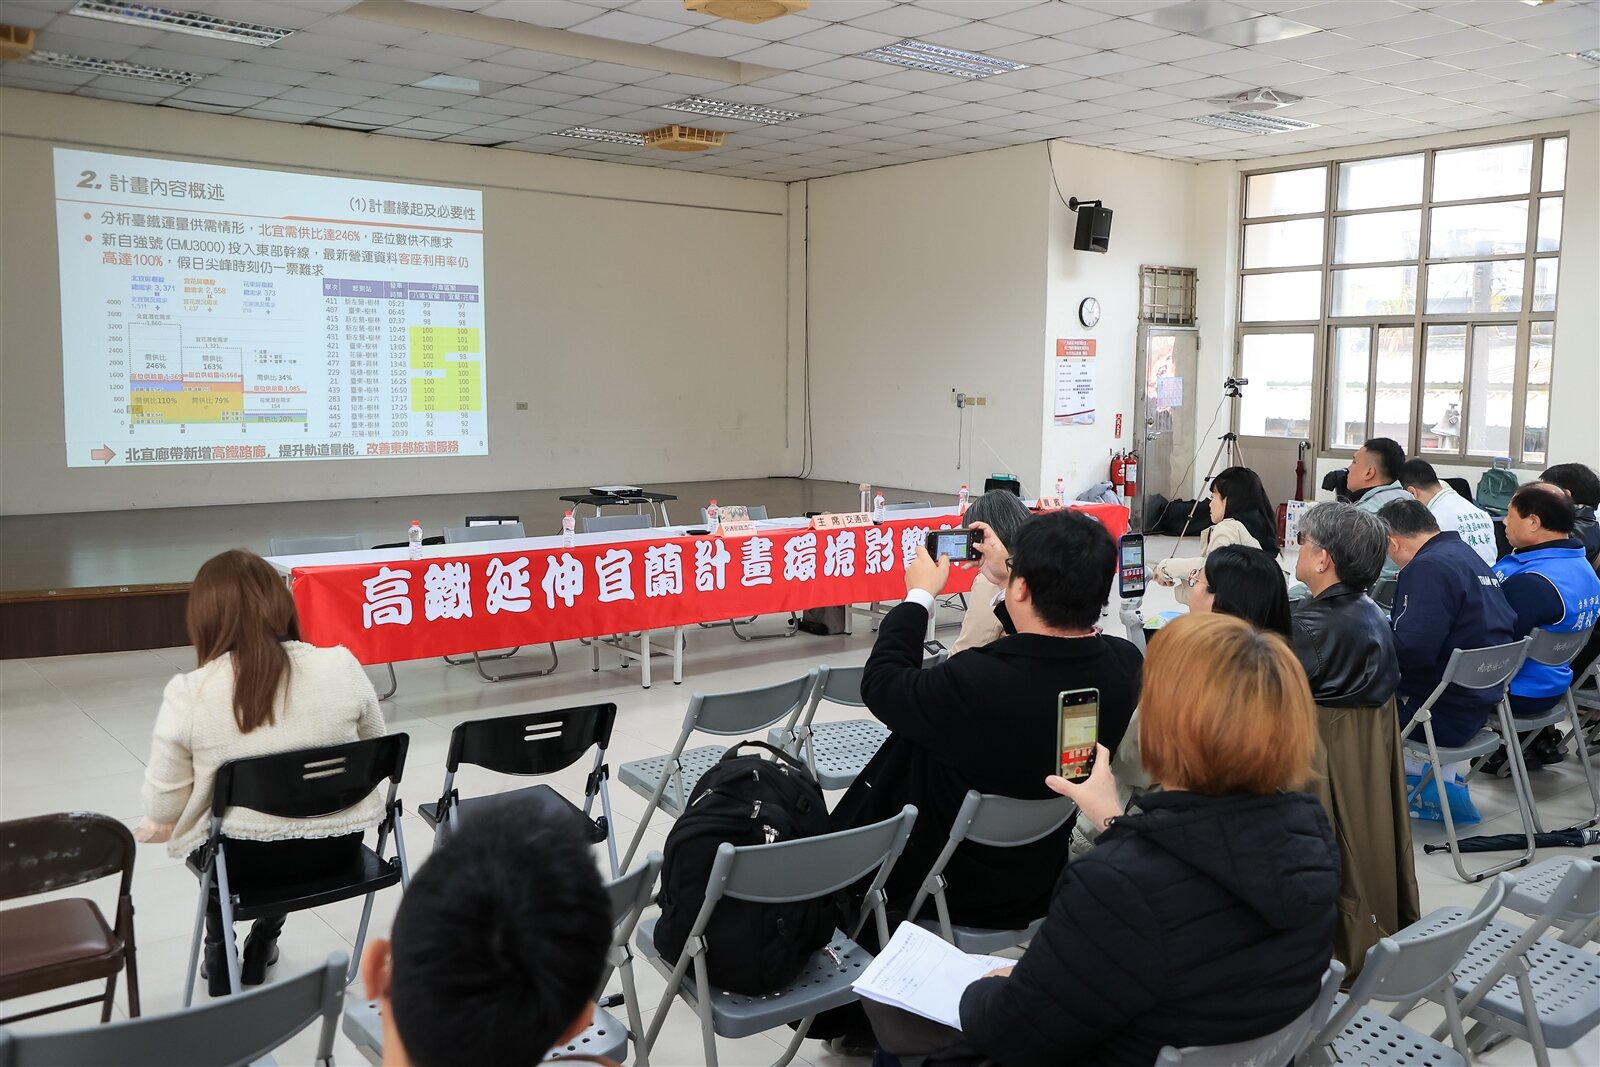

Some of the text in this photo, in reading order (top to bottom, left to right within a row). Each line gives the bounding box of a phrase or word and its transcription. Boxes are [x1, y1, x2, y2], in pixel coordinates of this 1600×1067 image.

[76, 170, 225, 200] 2. 計畫內容概述
[362, 524, 962, 629] 高鐵延伸宜蘭計畫環境影響
